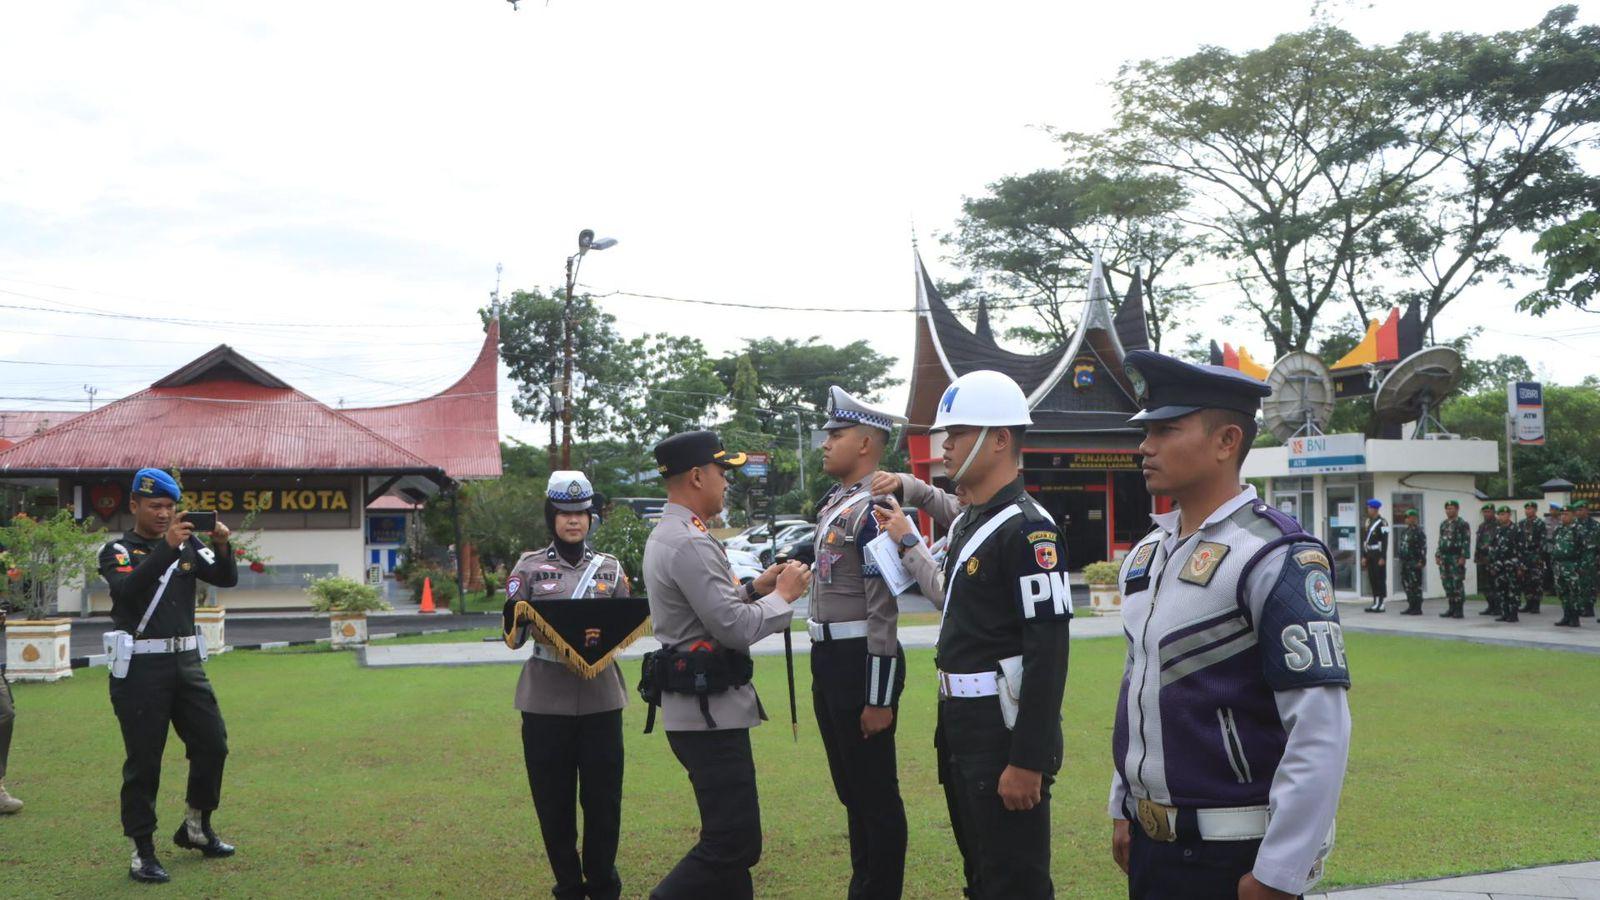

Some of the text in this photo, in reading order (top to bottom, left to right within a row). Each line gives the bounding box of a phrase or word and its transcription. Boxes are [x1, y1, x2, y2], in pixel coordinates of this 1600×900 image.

[1307, 439, 1326, 452] BNI
[243, 491, 273, 511] 50
[281, 491, 348, 510] KOTA
[1020, 571, 1073, 618] PM
